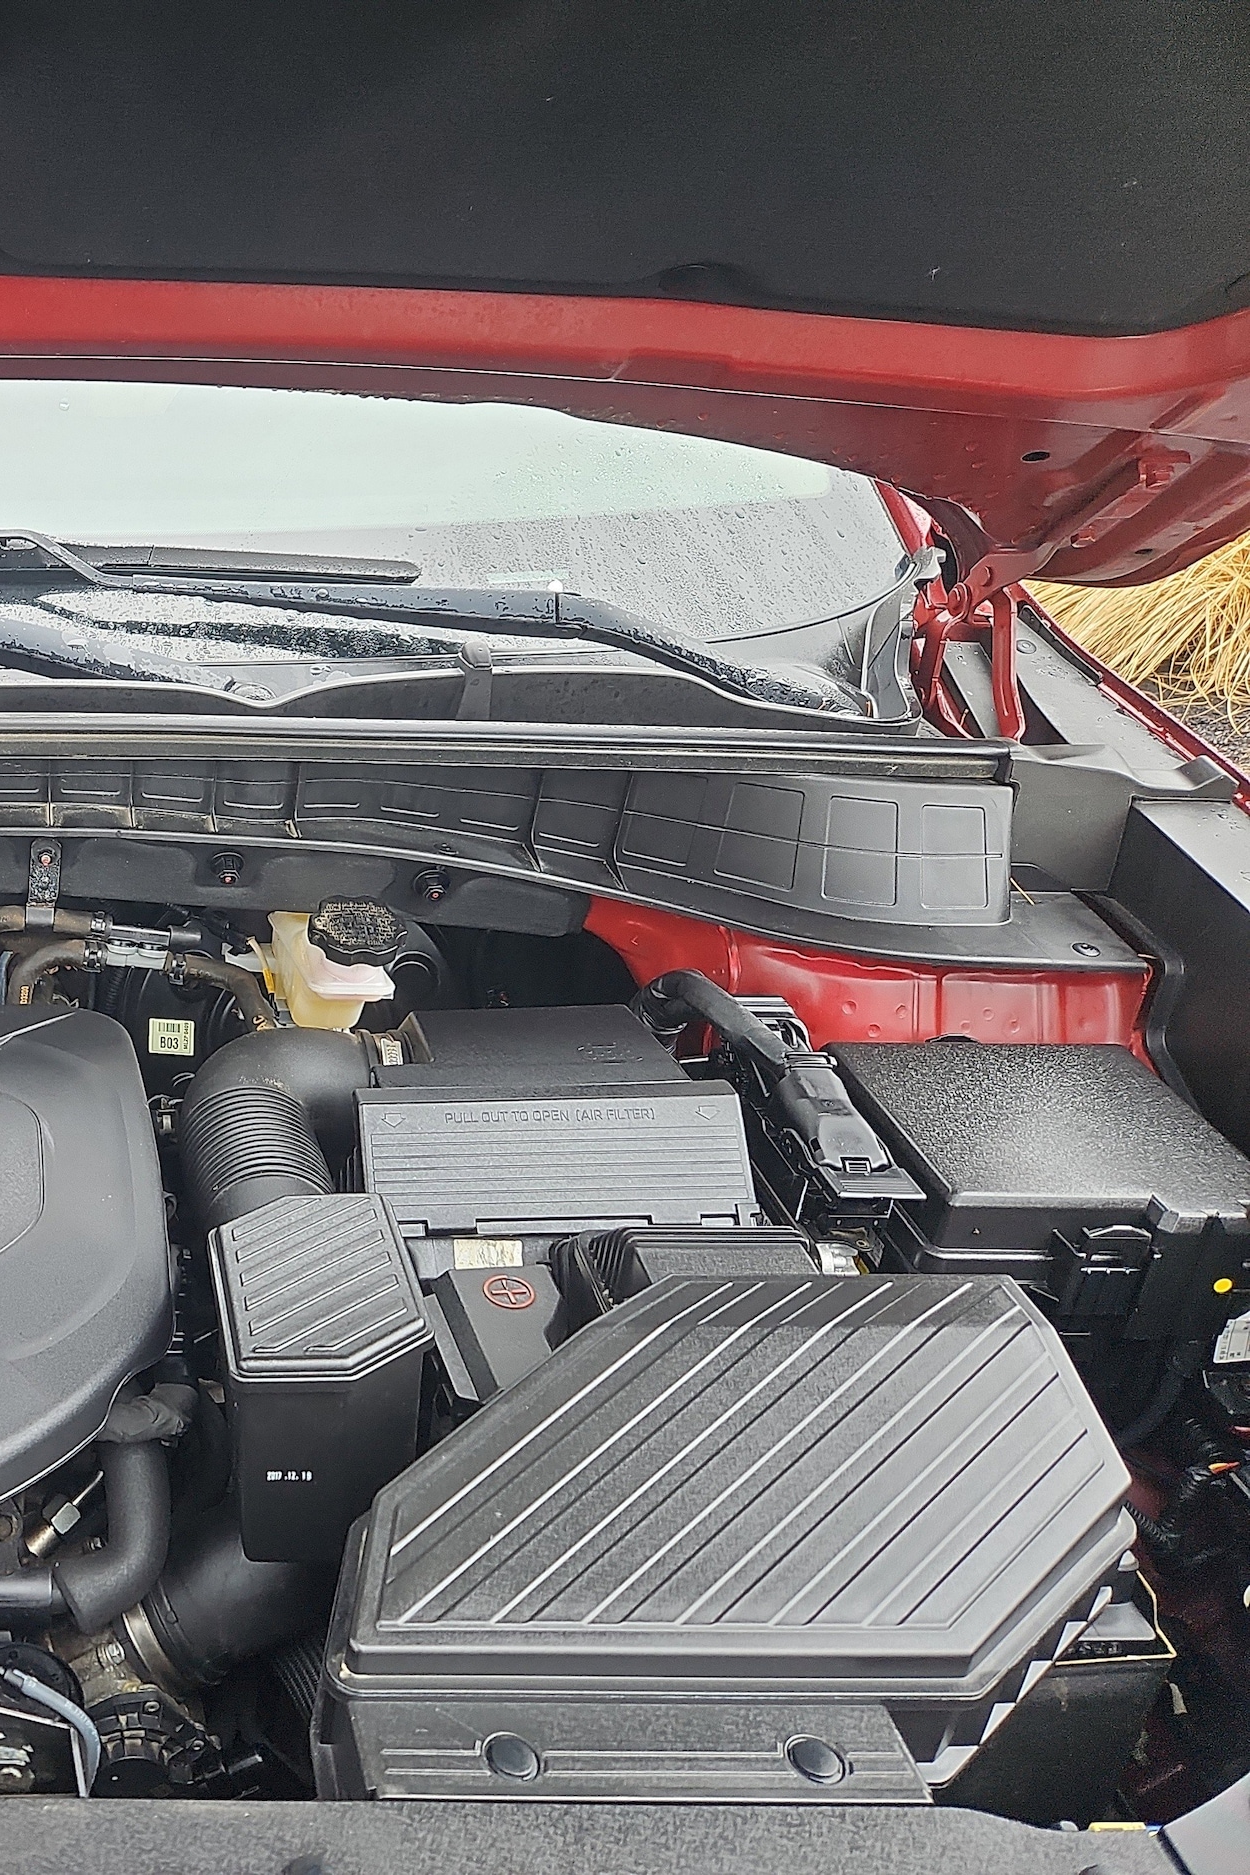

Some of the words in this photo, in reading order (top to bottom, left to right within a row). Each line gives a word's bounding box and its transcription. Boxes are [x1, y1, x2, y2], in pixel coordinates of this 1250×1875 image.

[160, 1036, 179, 1050] B03
[444, 1112, 479, 1124] PULL
[481, 1111, 508, 1123] OUT
[511, 1110, 529, 1122] TO
[532, 1109, 570, 1122] OPEN
